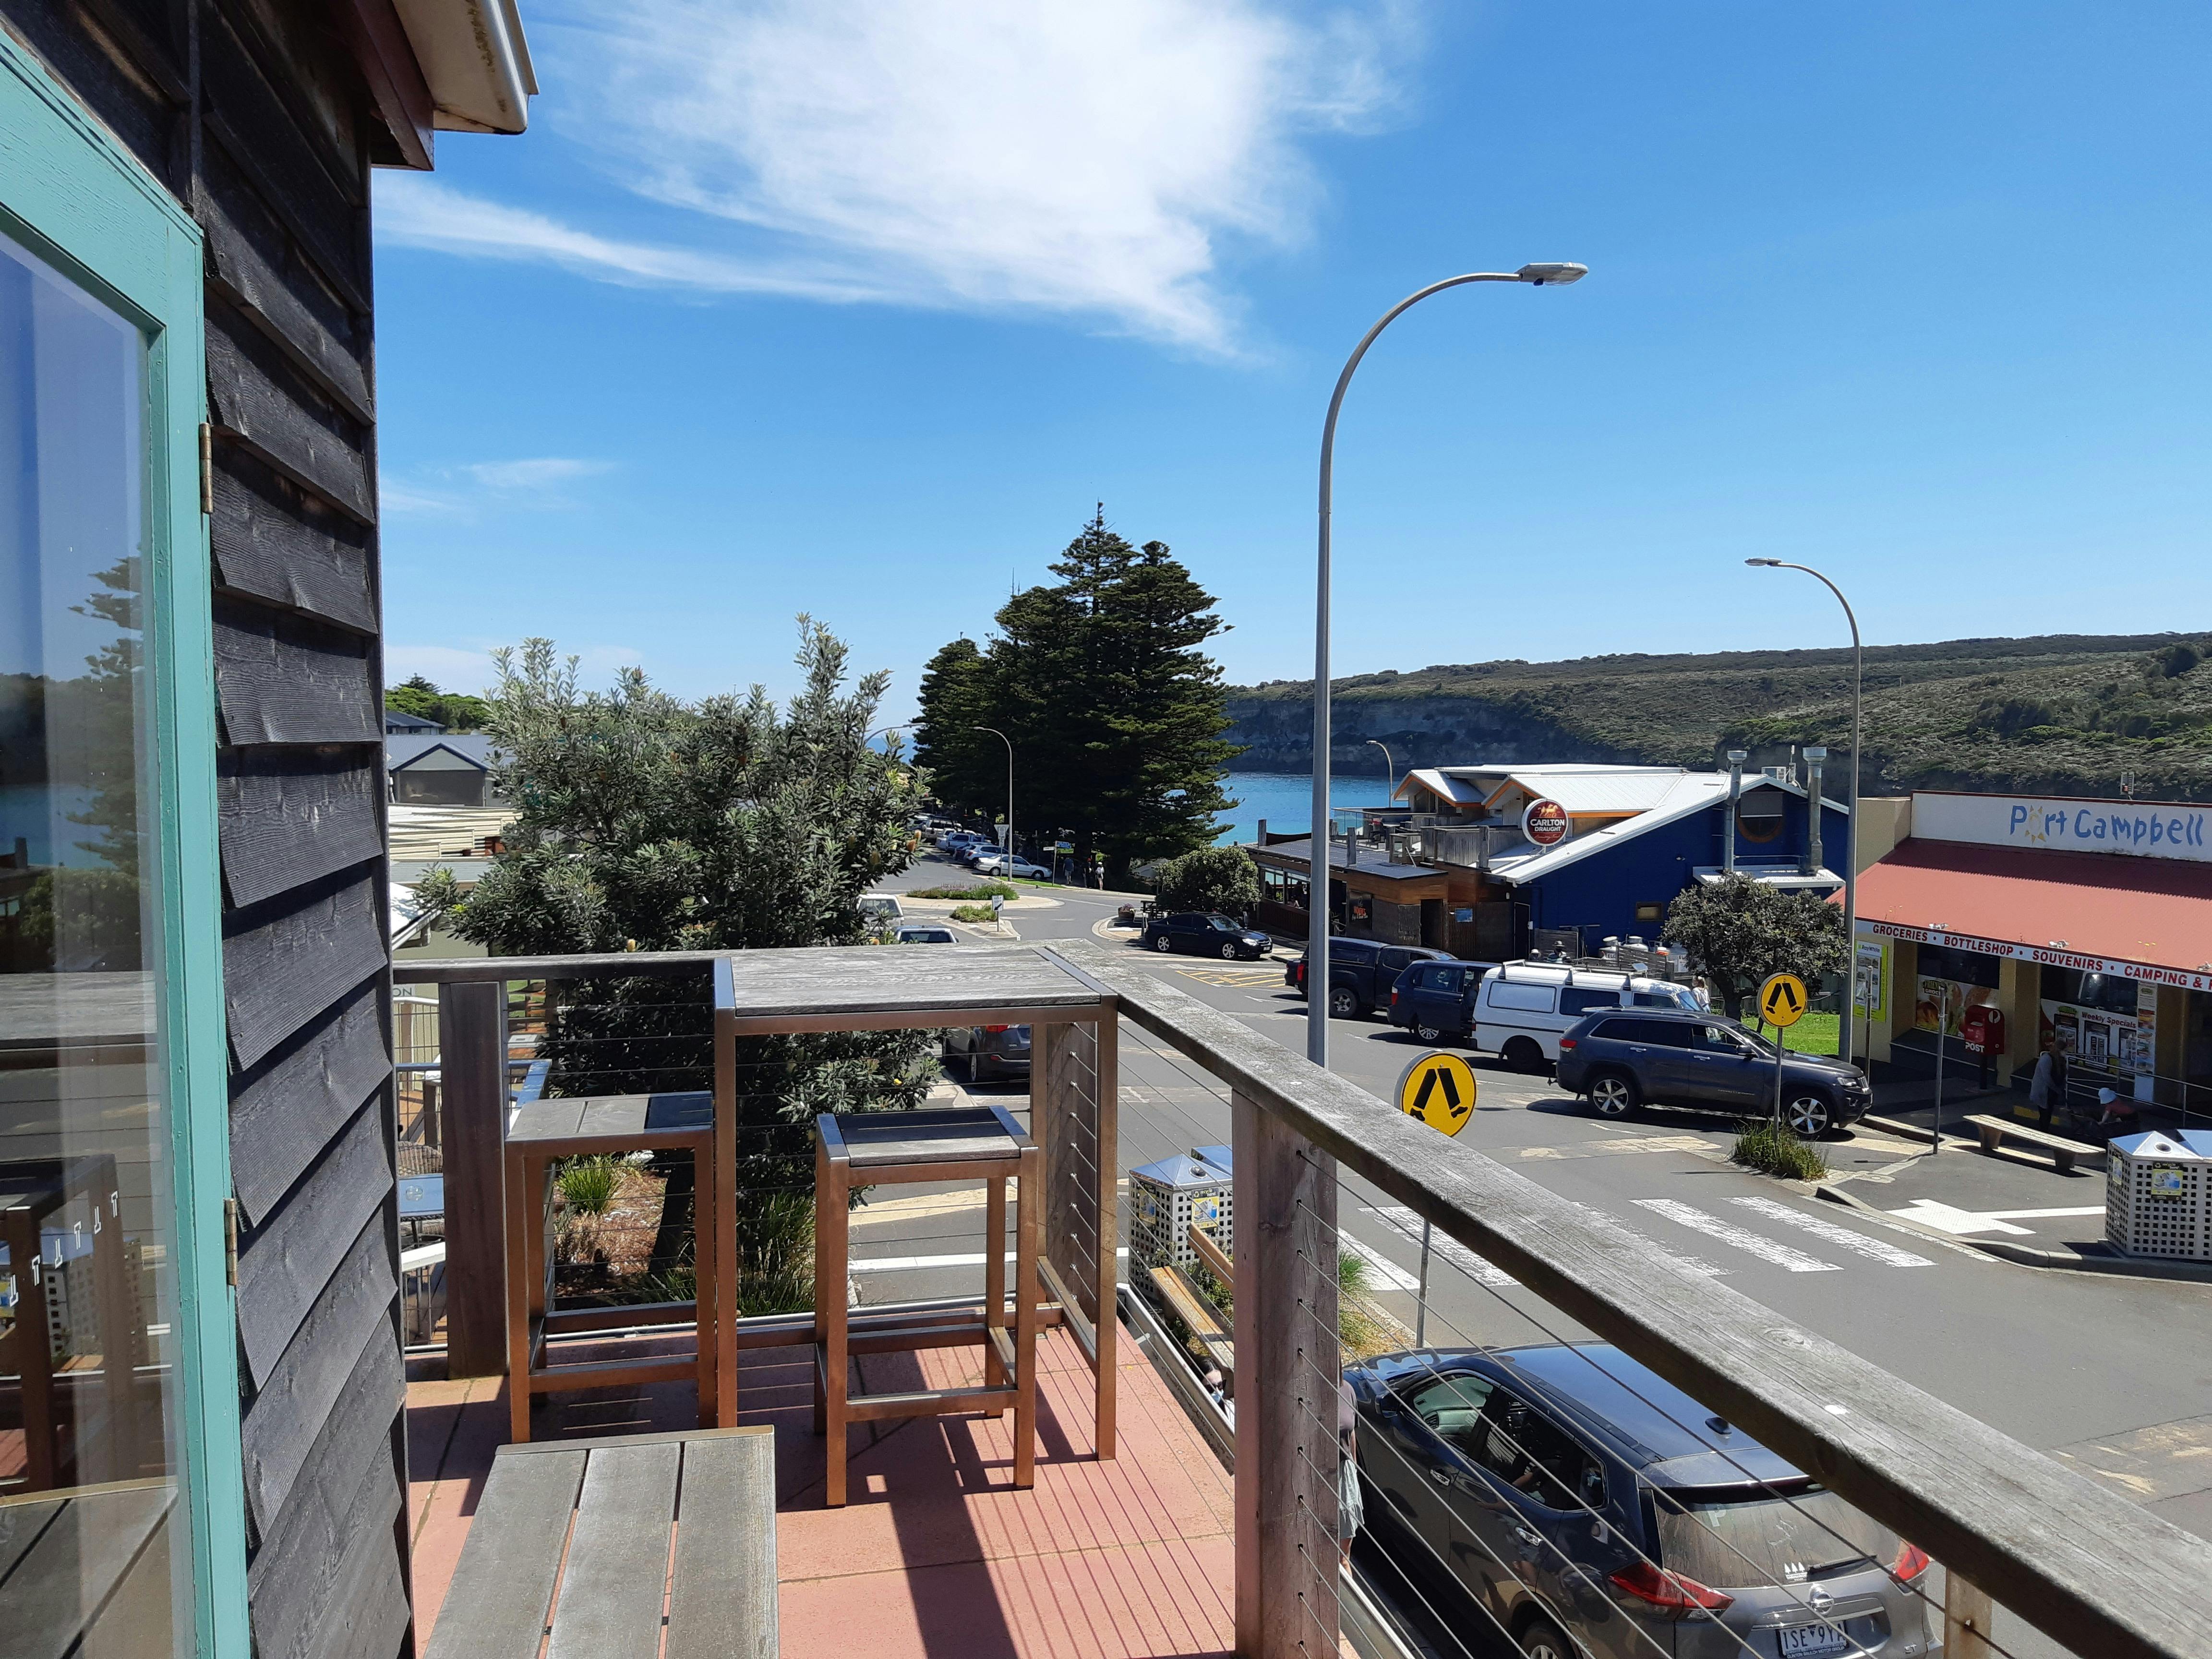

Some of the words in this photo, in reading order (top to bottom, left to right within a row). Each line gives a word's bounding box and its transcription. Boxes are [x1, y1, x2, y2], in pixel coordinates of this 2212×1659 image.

[2074, 809, 2203, 846] Campbell
[1873, 924, 1928, 942] GROCERIES
[1944, 936, 2014, 956] BOTTLESHOP
[2032, 950, 2104, 972] SOUVENIRS
[2124, 965, 2188, 986] CAMPING
[2192, 976, 2203, 988] &
[2081, 1011, 2105, 1023] Weekly
[2107, 1016, 2136, 1029] Specials
[1965, 1042, 1984, 1053] POST
[1905, 1644, 1917, 1654] ST
